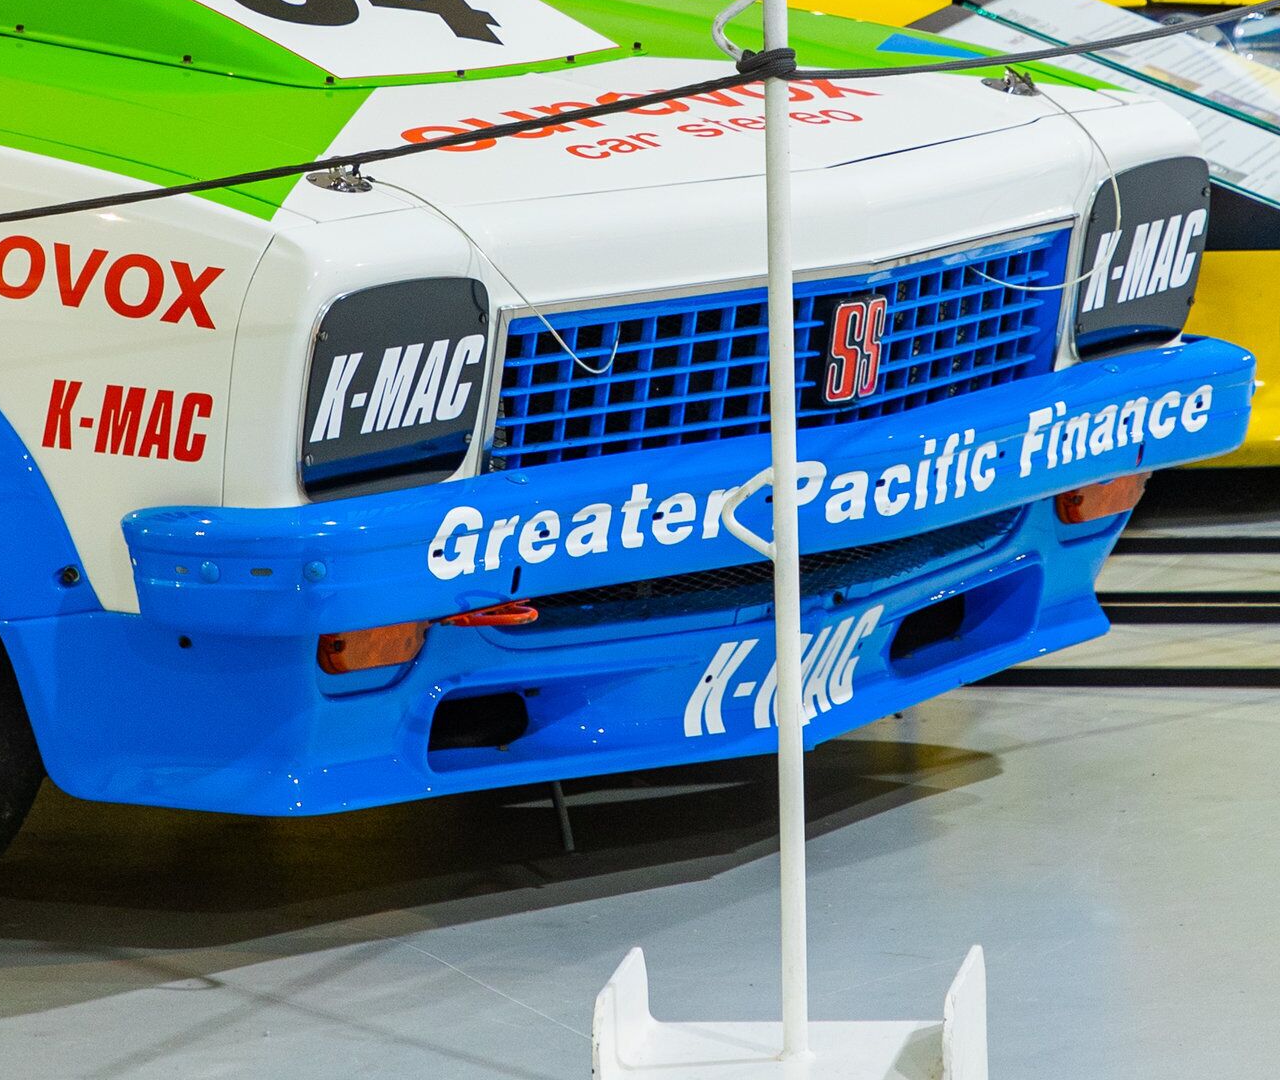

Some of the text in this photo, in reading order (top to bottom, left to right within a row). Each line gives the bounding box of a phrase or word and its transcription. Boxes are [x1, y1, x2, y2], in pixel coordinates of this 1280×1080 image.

[565, 108, 864, 160] car steeo
[1081, 208, 1208, 314] K-MAC
[309, 333, 486, 444] K-MAC
[825, 297, 888, 402] SS
[41, 379, 214, 463] K-MAC
[427, 384, 1214, 581] Greater Pacific Finance
[683, 604, 885, 738] K-MAC
